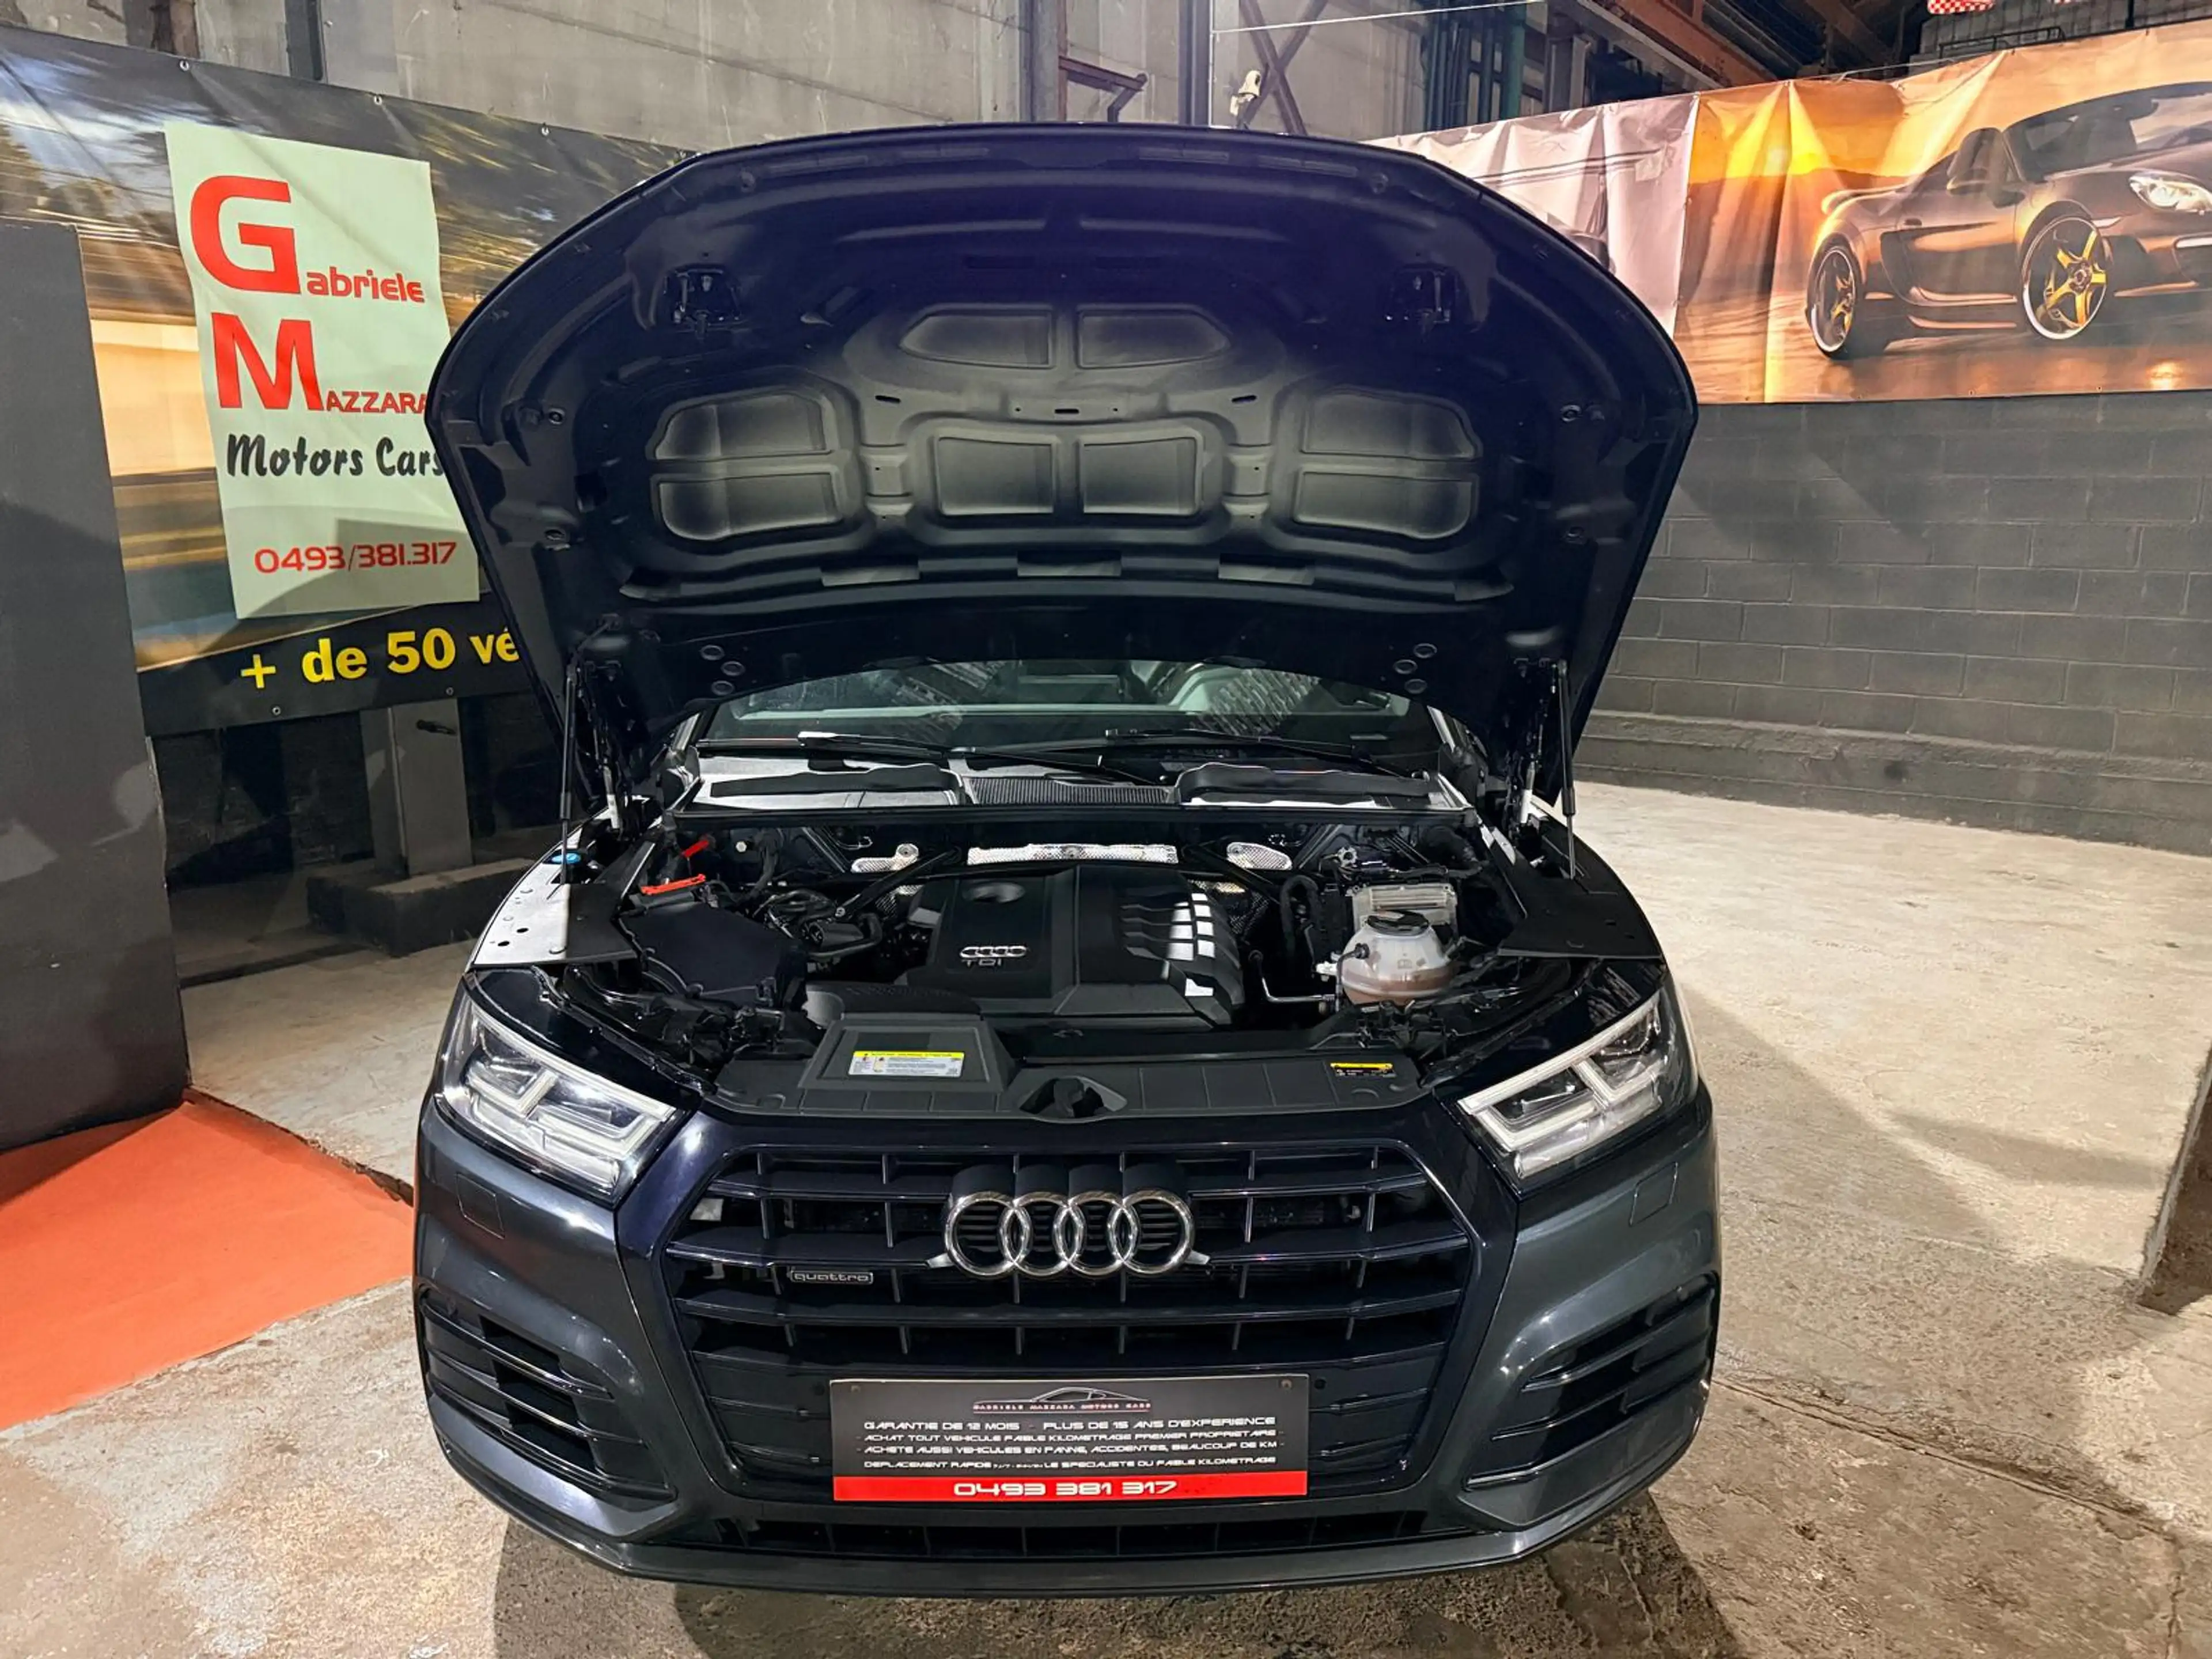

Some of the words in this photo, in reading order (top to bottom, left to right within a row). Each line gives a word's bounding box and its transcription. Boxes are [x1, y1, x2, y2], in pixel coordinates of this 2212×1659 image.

[191, 175, 425, 303] Gabriele
[227, 433, 363, 477] Motors
[254, 542, 457, 574] 0493/381.317
[301, 638, 367, 684] de
[387, 627, 456, 674] 50
[961, 958, 1002, 968] TDI
[794, 1272, 869, 1282] quattro
[864, 1422, 938, 1430] GARANTIE
[942, 1422, 963, 1430] DE
[984, 1422, 1020, 1430] MOIS
[1043, 1422, 1085, 1430] PLUS
[1088, 1421, 1109, 1429] DE
[1112, 1420, 1129, 1429] 15
[1132, 1419, 1164, 1429] ANS
[1168, 1416, 1276, 1428] D'EXPERIENCE
[1134, 1432, 1187, 1440] PREMIER
[864, 1446, 914, 1454] ACHETE
[916, 1446, 953, 1454] AUSSI
[956, 1446, 1022, 1454] VEHICULES
[1024, 1446, 1042, 1454] EN
[1171, 1441, 1238, 1451] BEAUCOUP
[1259, 1441, 1277, 1449] KM
[1061, 1460, 1135, 1468] SPECIALISTE
[1137, 1459, 1154, 1467] DU
[1198, 1456, 1277, 1466] KILOMETRAGE
[954, 1482, 1046, 1496] 0493
[1055, 1482, 1112, 1495] 381
[1122, 1480, 1177, 1495] 317
